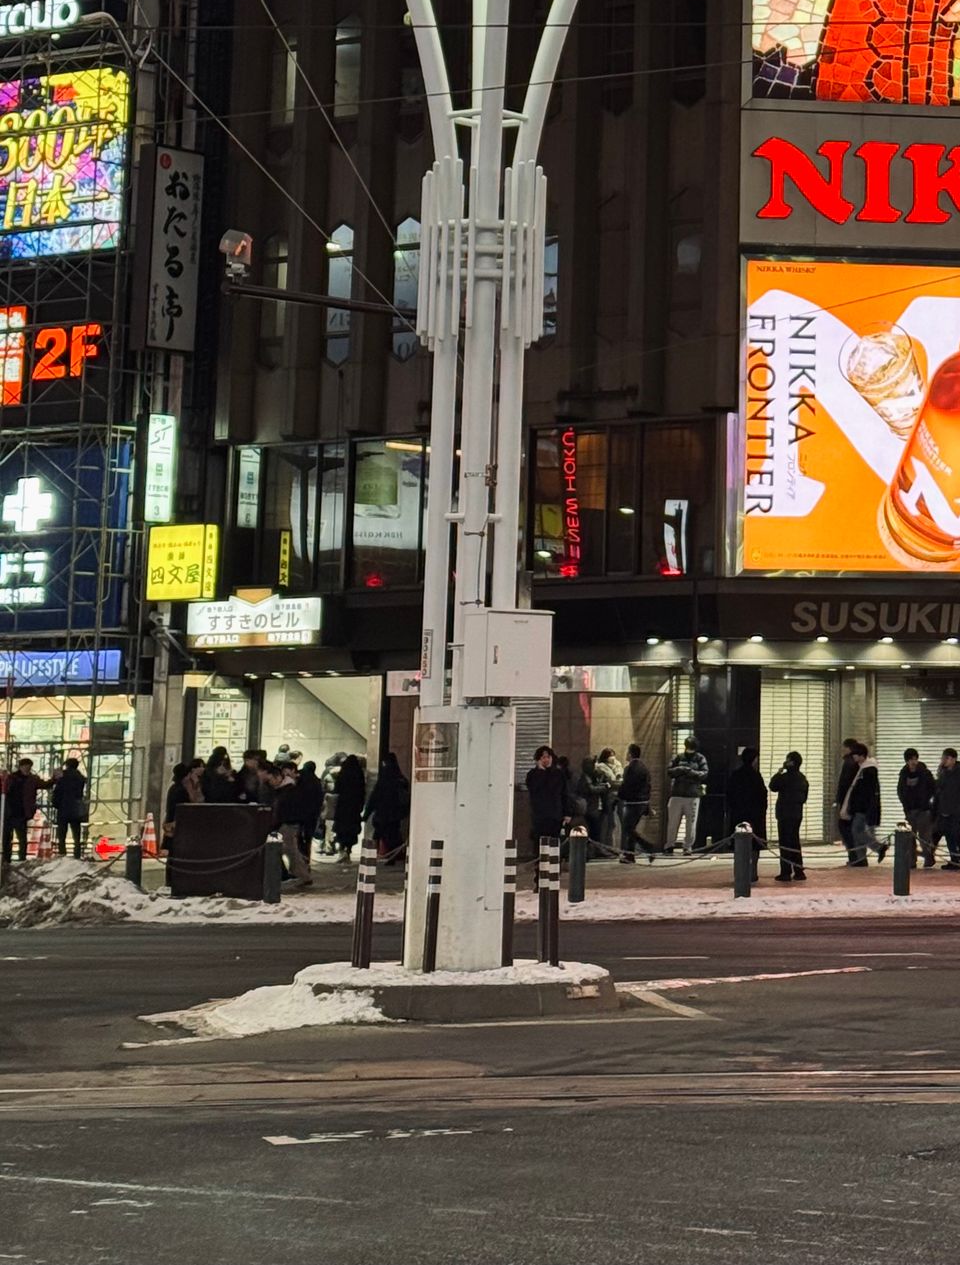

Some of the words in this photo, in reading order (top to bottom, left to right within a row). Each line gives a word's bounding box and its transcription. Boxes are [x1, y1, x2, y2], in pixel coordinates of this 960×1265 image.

[31, 323, 102, 380] 2F
[788, 314, 817, 445] NIKKA
[745, 314, 777, 516] FRONTIER
[151, 563, 200, 585] 四文屋
[208, 611, 300, 631] すすきのビル
[21, 657, 79, 677] LIFESTYLE
